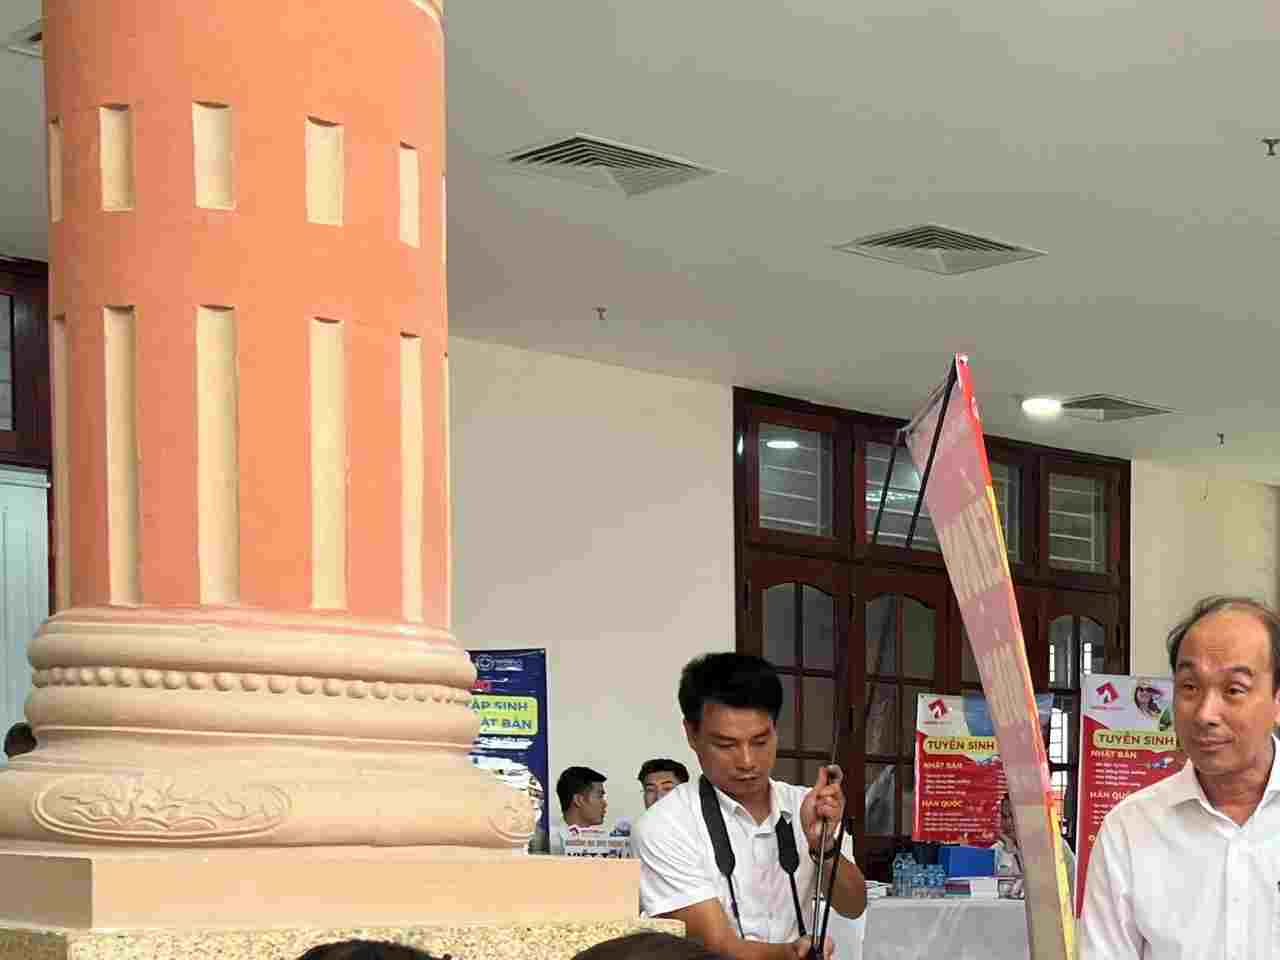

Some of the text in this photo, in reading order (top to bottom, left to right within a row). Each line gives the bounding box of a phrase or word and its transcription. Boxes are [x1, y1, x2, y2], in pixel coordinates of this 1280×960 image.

[495, 701, 529, 712] SINH
[501, 716, 532, 730] BẢN
[926, 737, 995, 751] TUYỂN SINH
[1098, 731, 1175, 746] TUYỂN SINH
